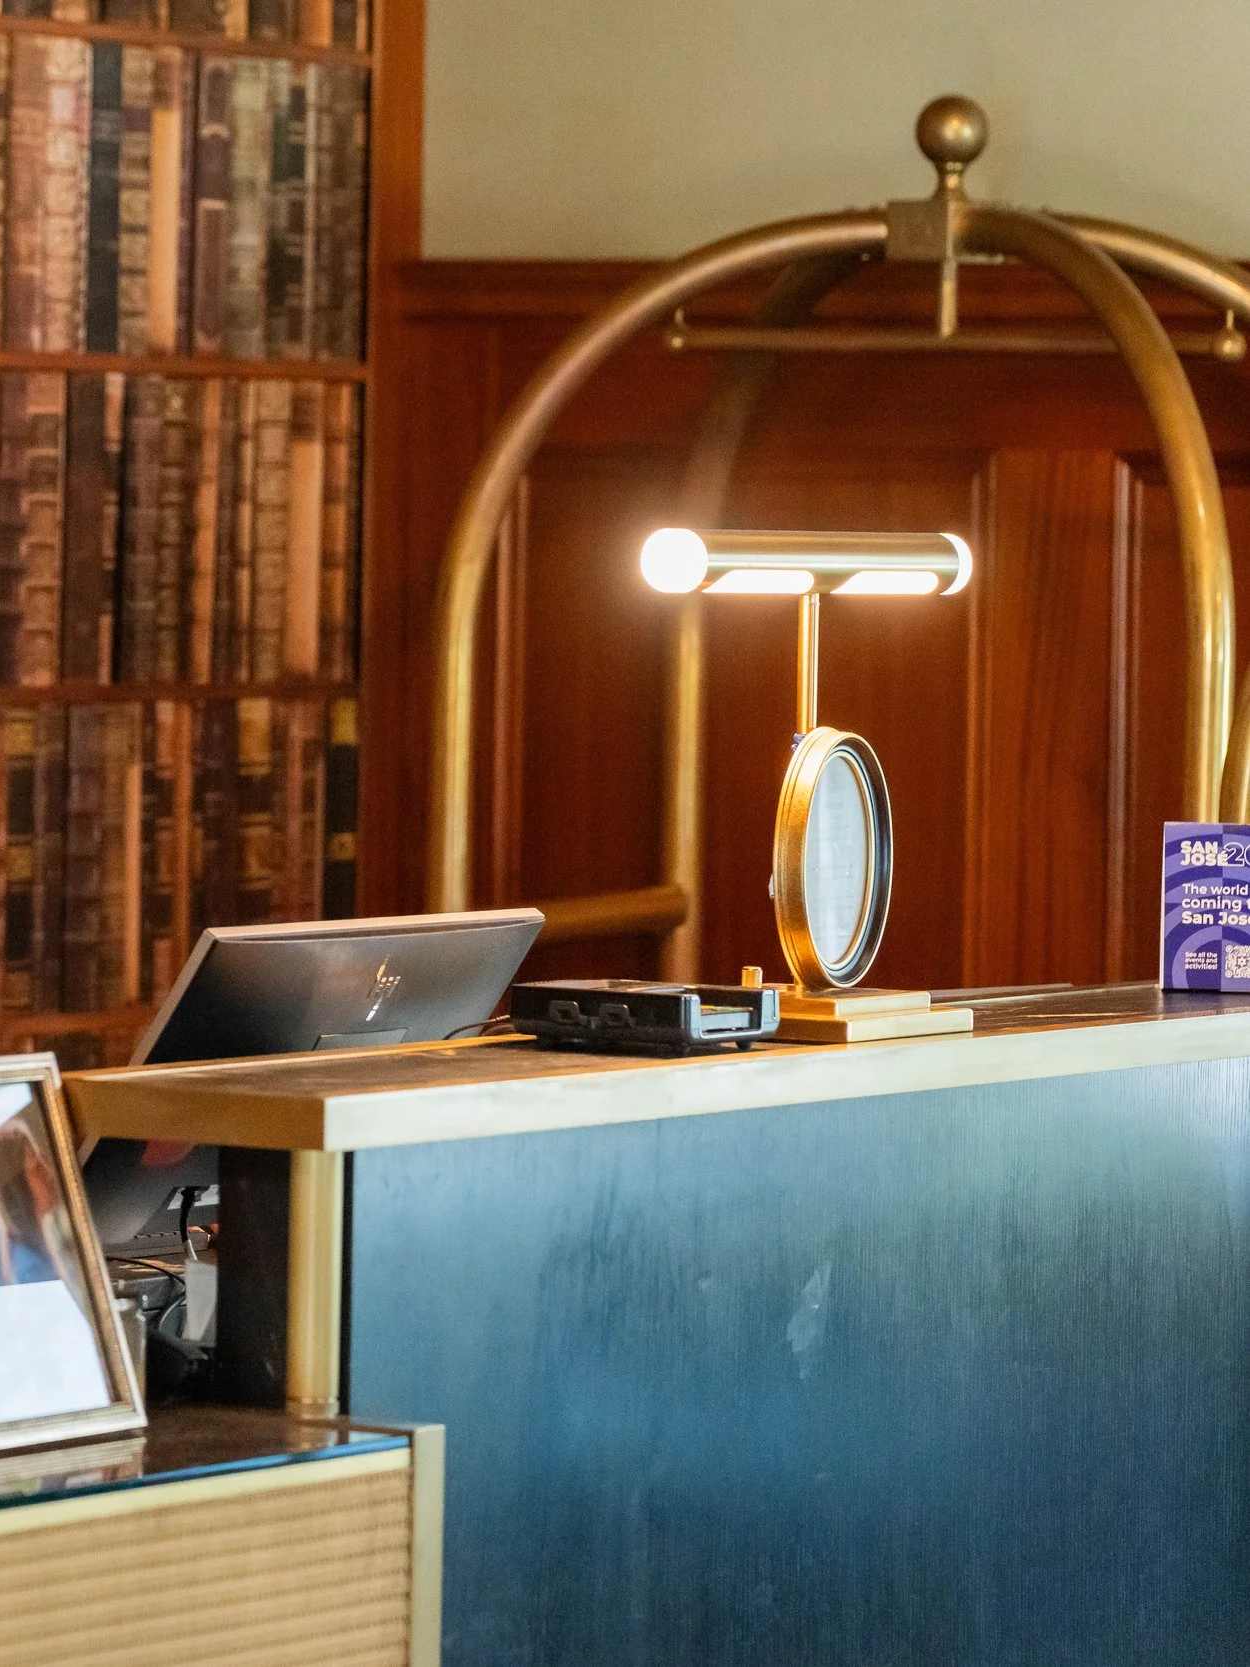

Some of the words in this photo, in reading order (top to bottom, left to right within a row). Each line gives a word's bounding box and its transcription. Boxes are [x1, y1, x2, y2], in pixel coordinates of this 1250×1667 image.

[1180, 840, 1218, 854] SAN
[1180, 850, 1229, 867] JOSÉ
[1224, 842, 1250, 867] 2
[1182, 883, 1208, 895] The
[1210, 884, 1249, 896] world
[1182, 896, 1242, 912] coming
[1181, 910, 1214, 925] San
[1217, 911, 1250, 926] Jos
